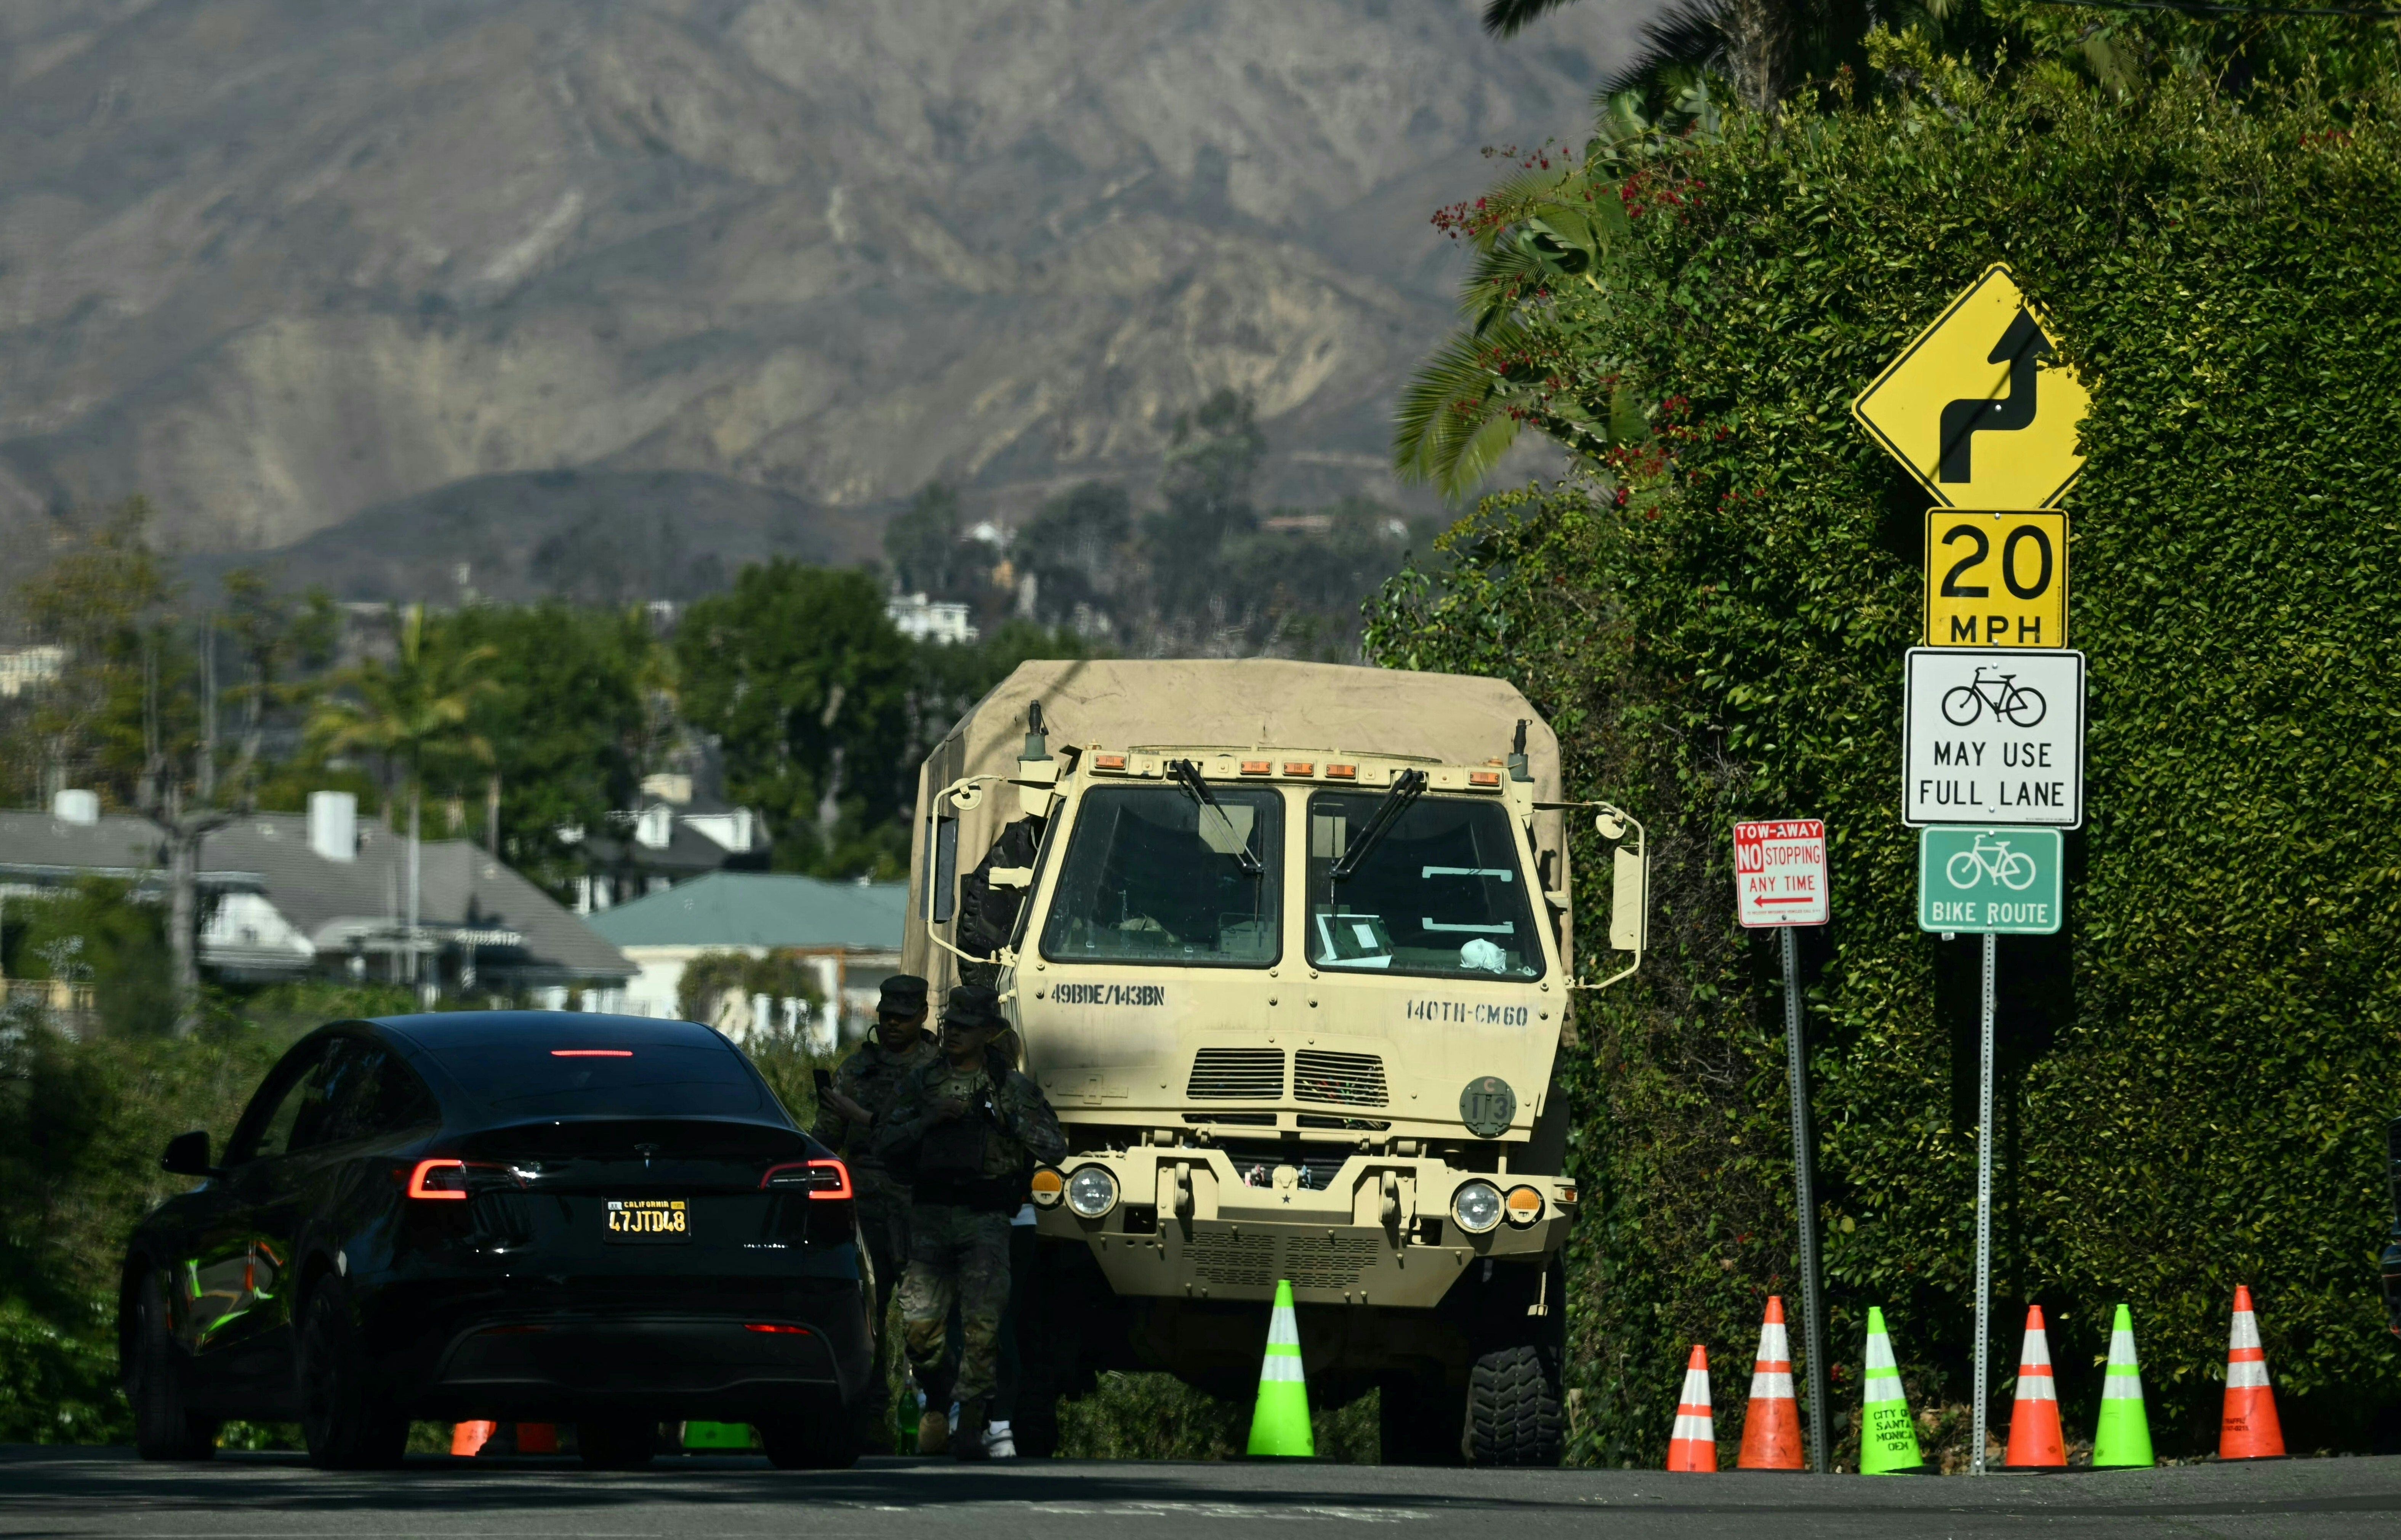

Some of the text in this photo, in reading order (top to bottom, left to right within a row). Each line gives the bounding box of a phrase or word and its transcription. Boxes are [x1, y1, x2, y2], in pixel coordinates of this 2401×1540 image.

[1941, 525, 2052, 599] 20
[1951, 615, 2041, 643] MPH
[1934, 741, 2052, 767] MAY USE
[1920, 780, 2064, 806] FULL LANE
[1738, 823, 1819, 839] TOW-AWAY
[1738, 844, 1820, 870] NO STOPPING
[1749, 875, 1815, 892] ANY TIME
[1932, 901, 2048, 923] BIKE ROUTE
[1051, 984, 1164, 1005] 49BDE/143BN
[1407, 1000, 1528, 1026] 140TH-CM60
[1484, 1078, 1496, 1092] C
[609, 1211, 685, 1232] 47JTD48
[1874, 1409, 1895, 1420] CITY
[1876, 1420, 1911, 1430] SANTA
[1876, 1431, 1913, 1442] MONICA
